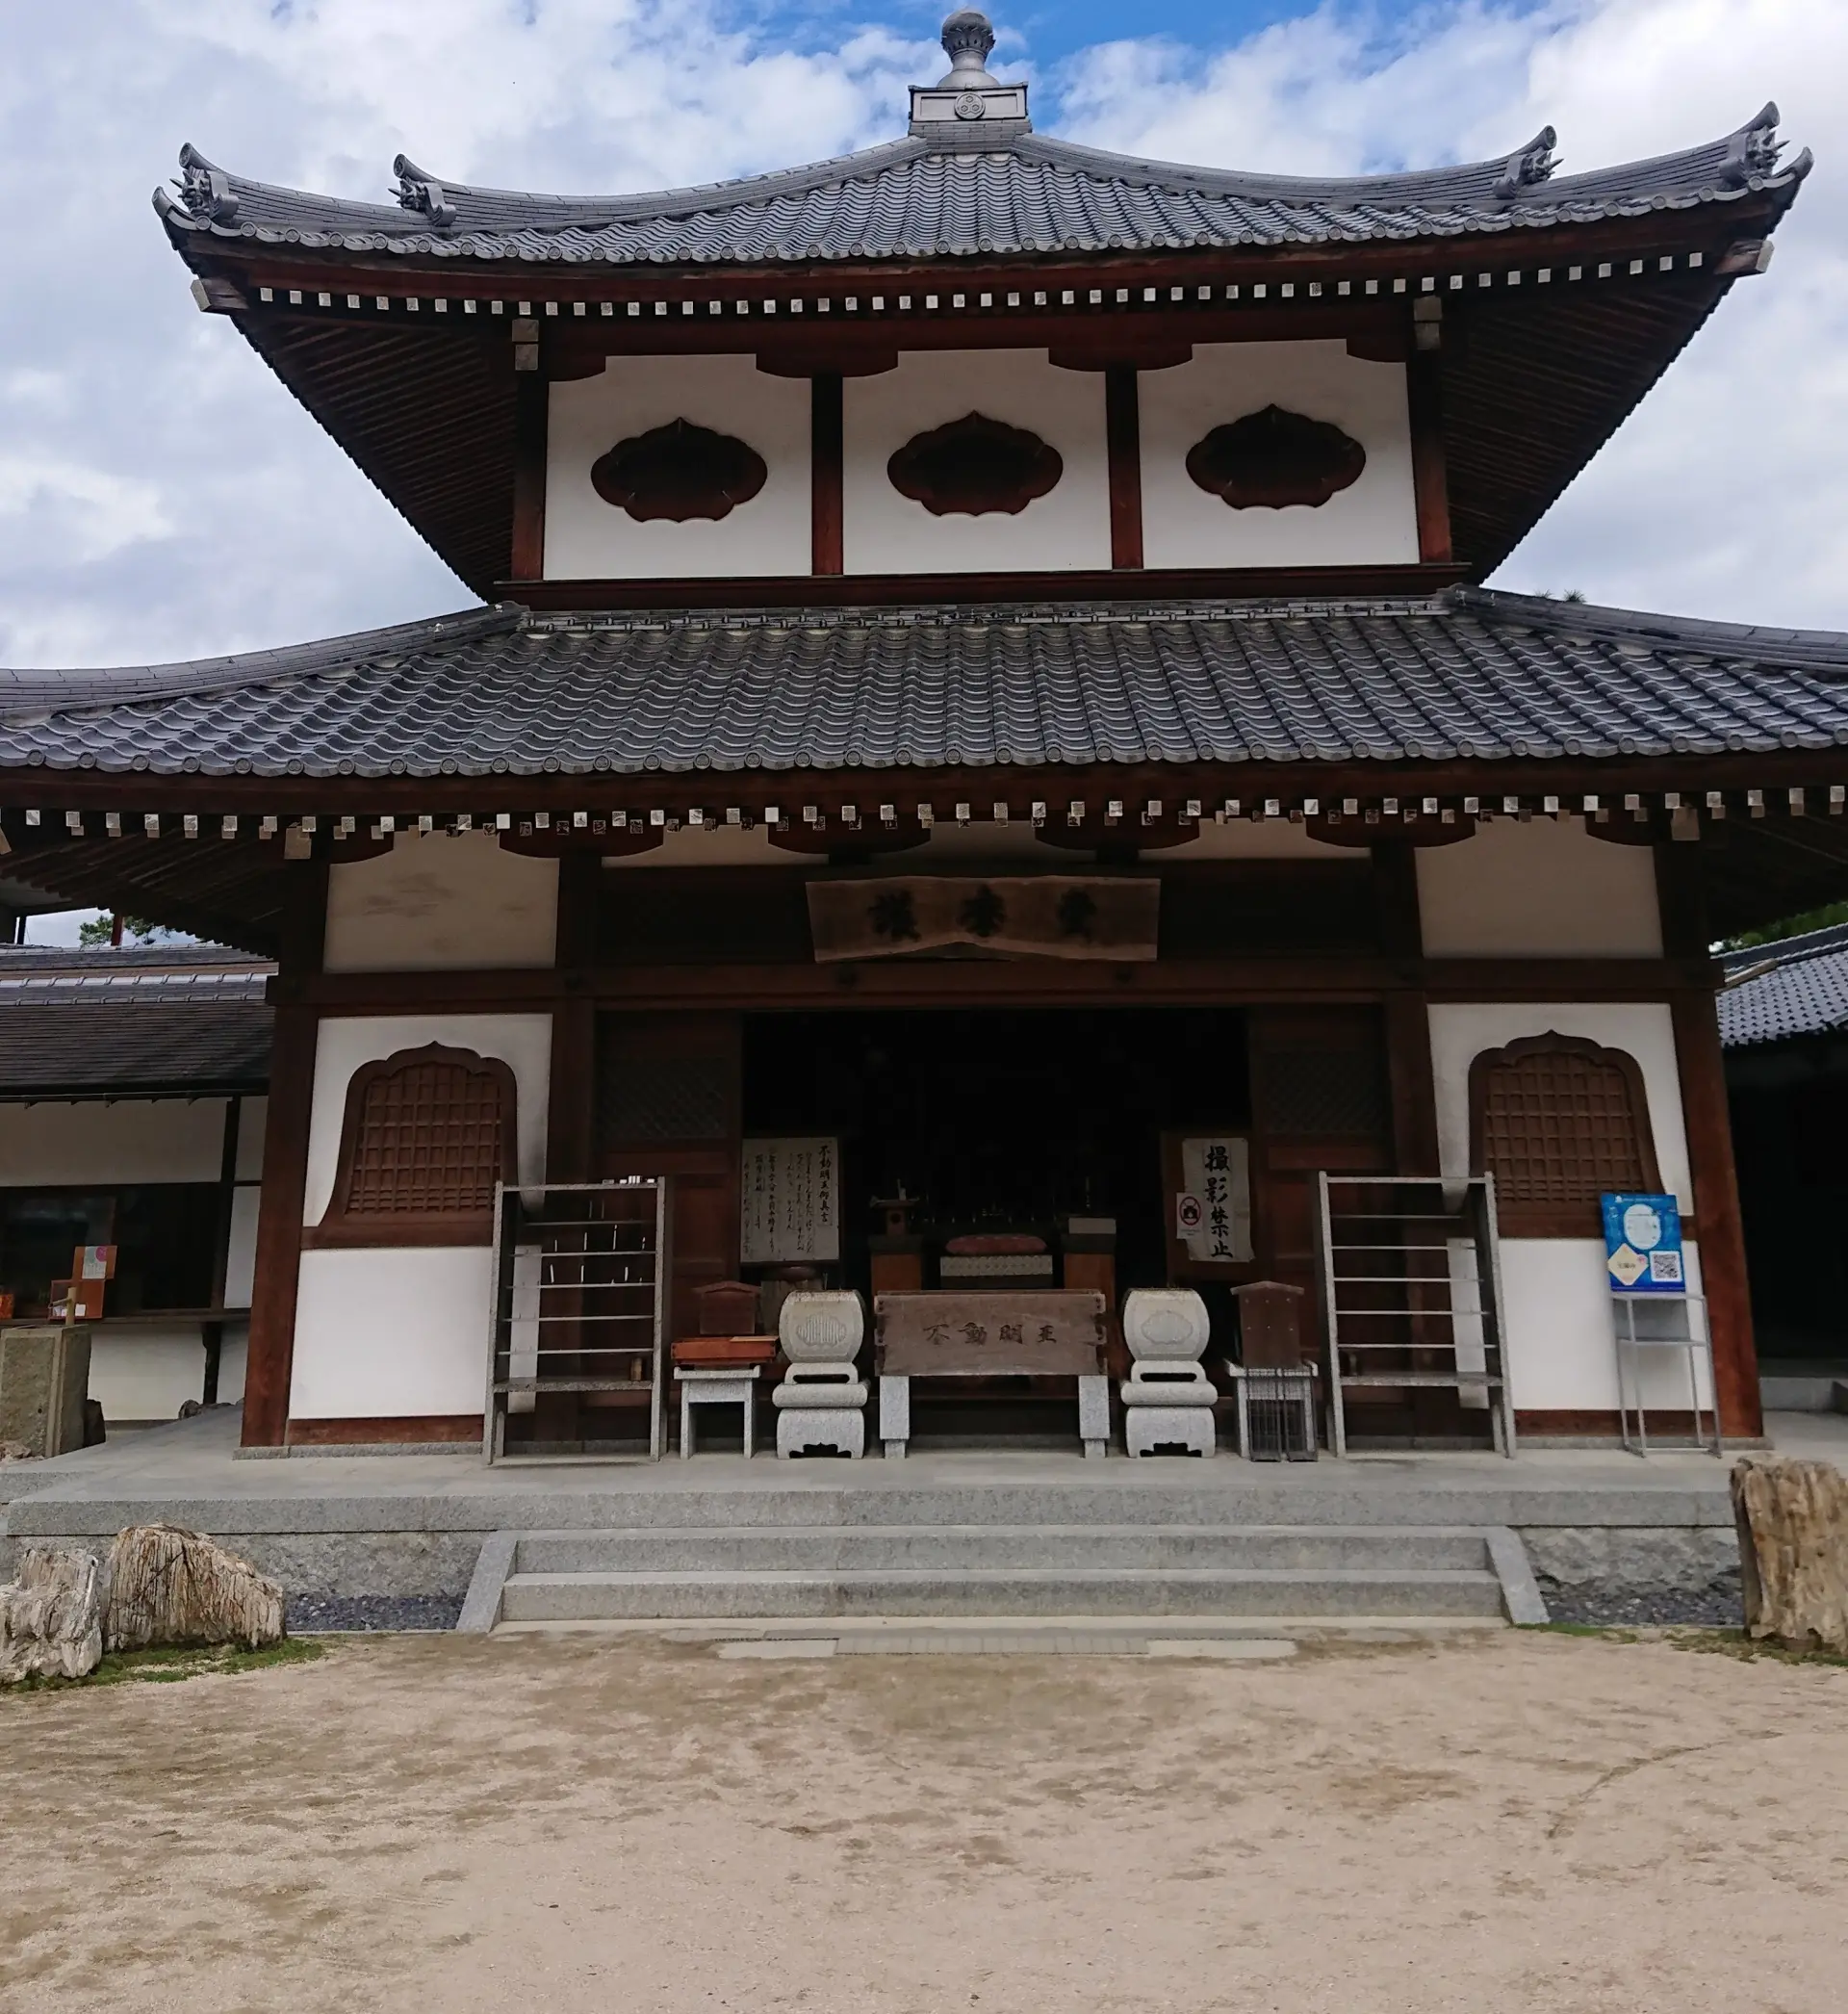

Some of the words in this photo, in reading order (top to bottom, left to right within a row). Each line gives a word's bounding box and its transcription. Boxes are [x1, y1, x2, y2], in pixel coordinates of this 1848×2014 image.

[817, 1145, 833, 1223] 不動明王御真言
[1204, 1145, 1234, 1259] 撮影禁止
[922, 1321, 1058, 1346] 不動明王
